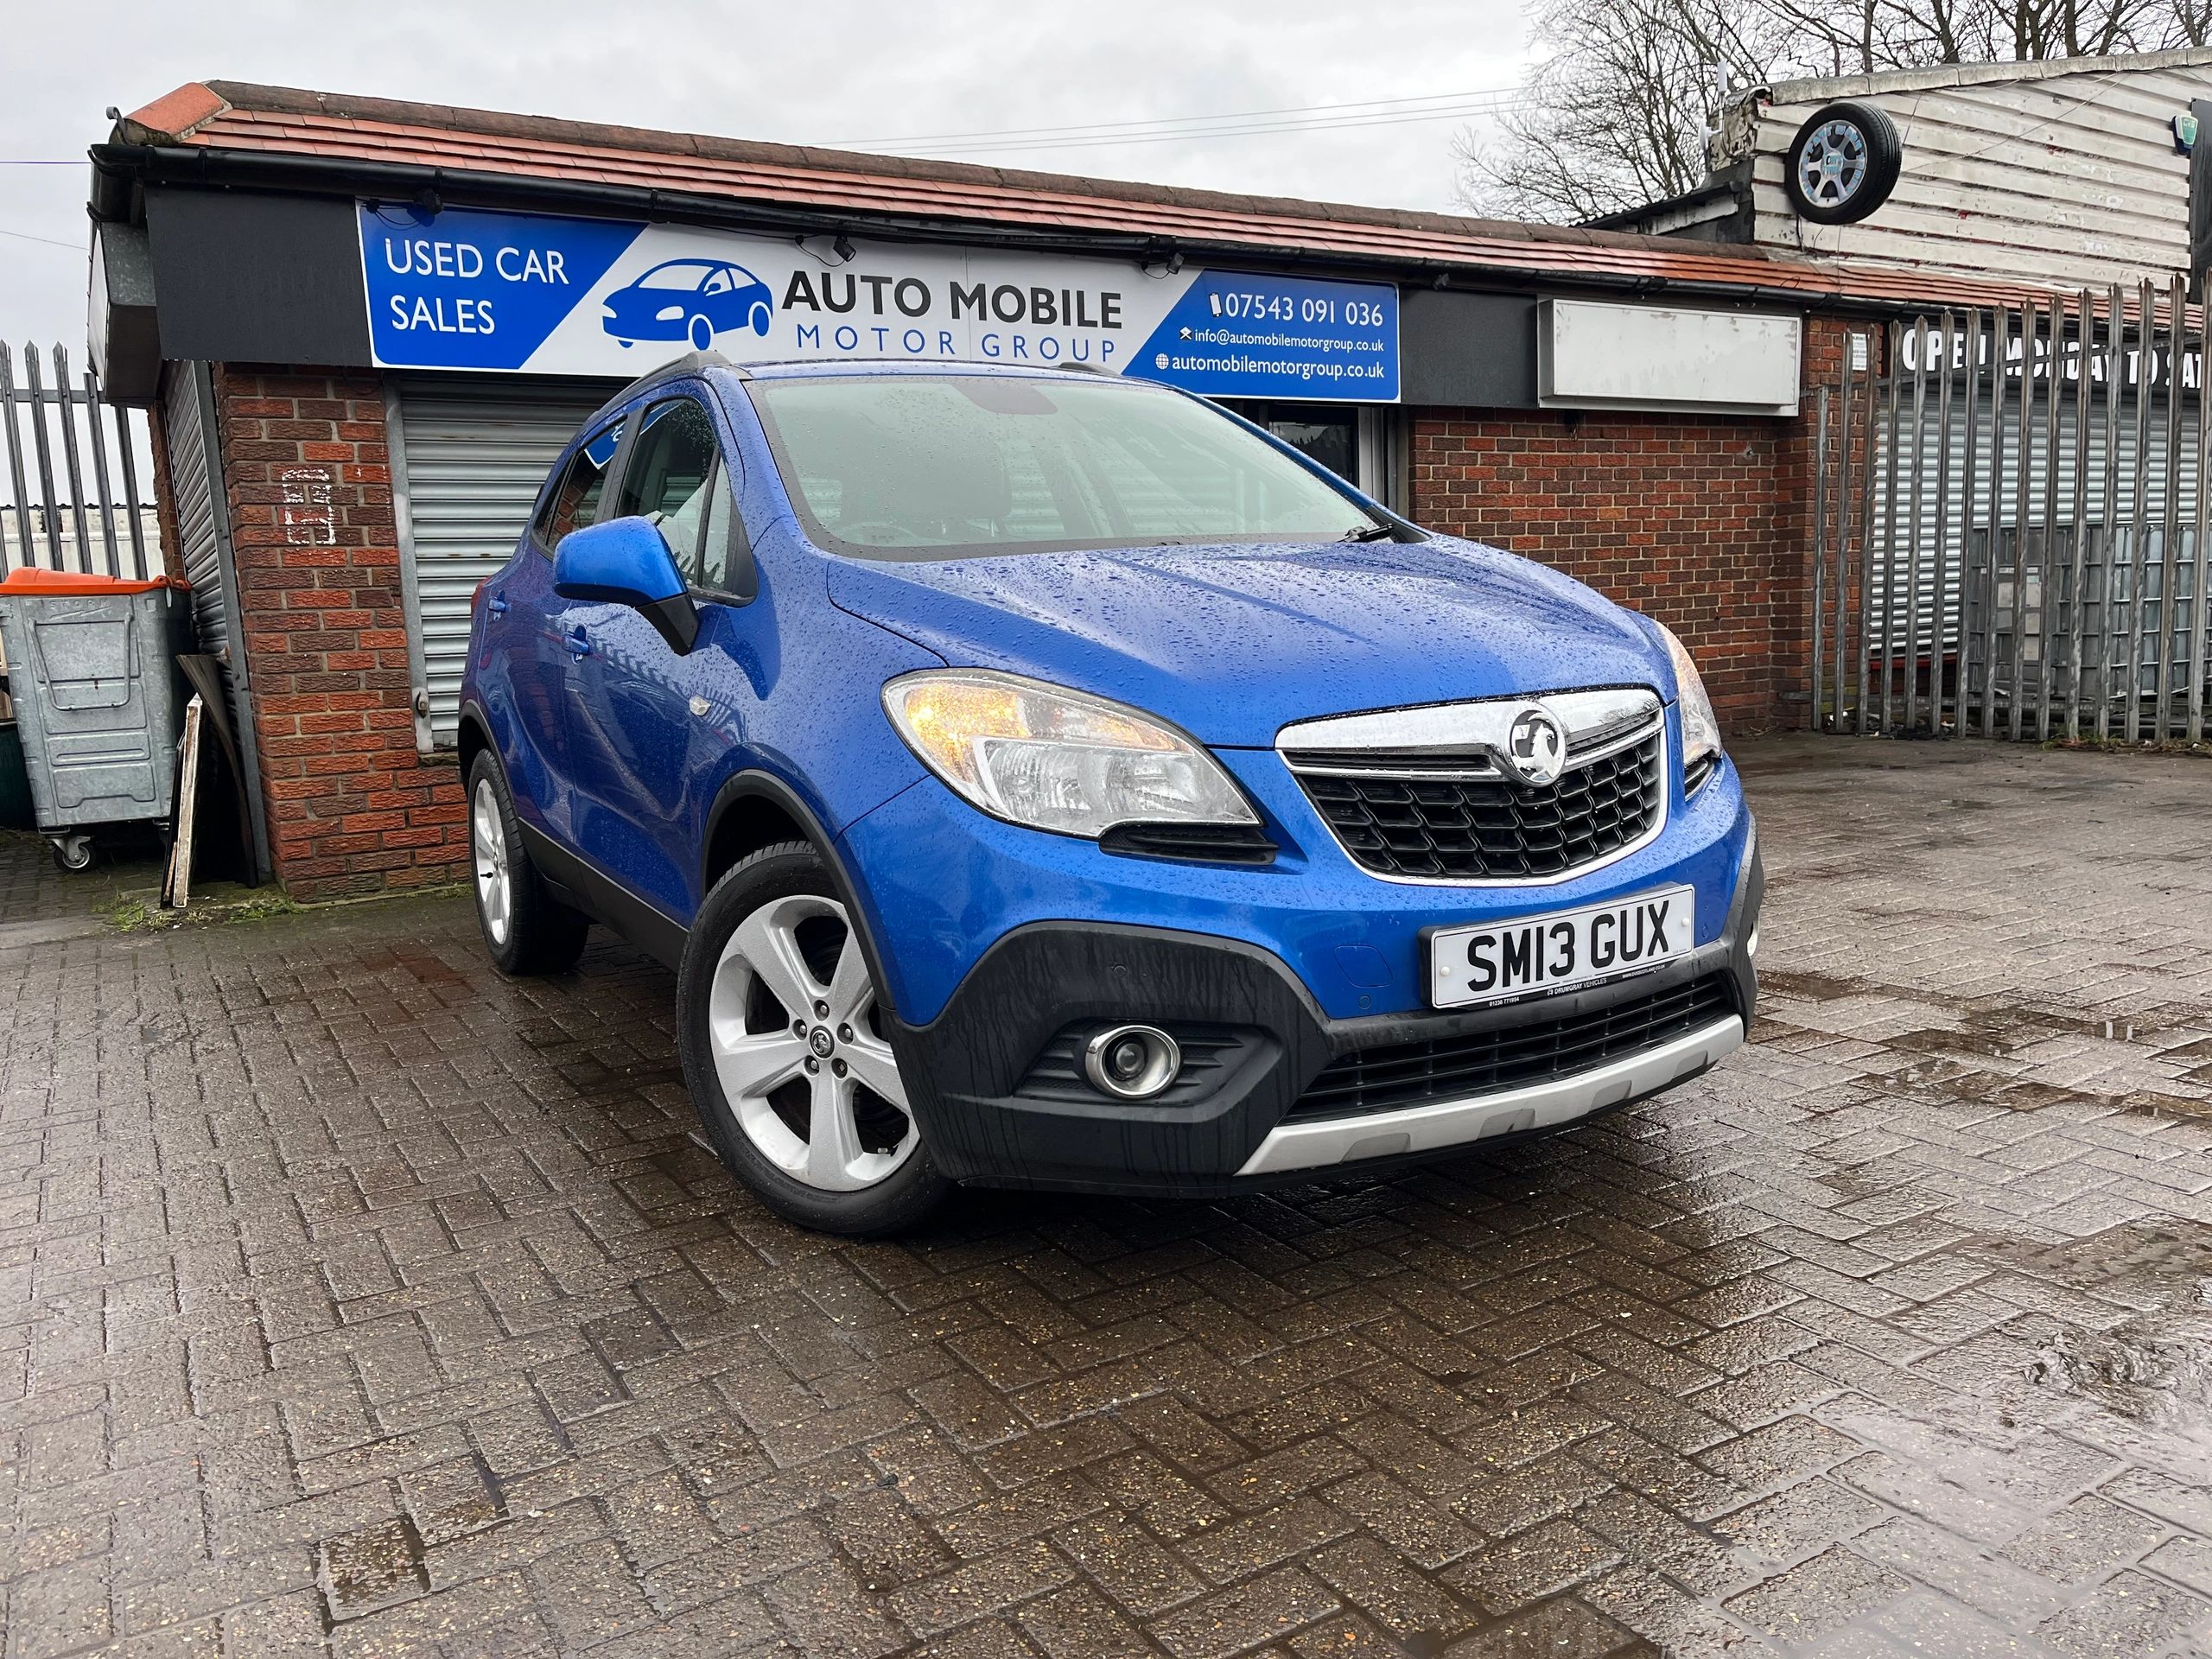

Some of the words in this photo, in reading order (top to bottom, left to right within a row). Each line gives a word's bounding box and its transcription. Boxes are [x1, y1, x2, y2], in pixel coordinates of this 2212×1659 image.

[385, 238, 484, 278] USED
[495, 246, 569, 285] CAR
[391, 295, 496, 335] SALES
[781, 270, 931, 317] AUTO
[949, 281, 1122, 329] MOBILE
[1225, 293, 1294, 321] 07543
[1301, 298, 1336, 323] 091
[1344, 302, 1383, 327] 036
[797, 324, 956, 355] MOTOR
[982, 334, 1116, 363] GROUP
[1194, 328, 1384, 353] info@automobilemotorgroup.co.uk
[1172, 354, 1385, 381] automobilemotorgroup.co.uk
[1466, 921, 1576, 992] SM13
[1590, 900, 1669, 969] GUX
[1554, 982, 1583, 995] DRUMGRAY
[1583, 977, 1607, 988] VEHICLES
